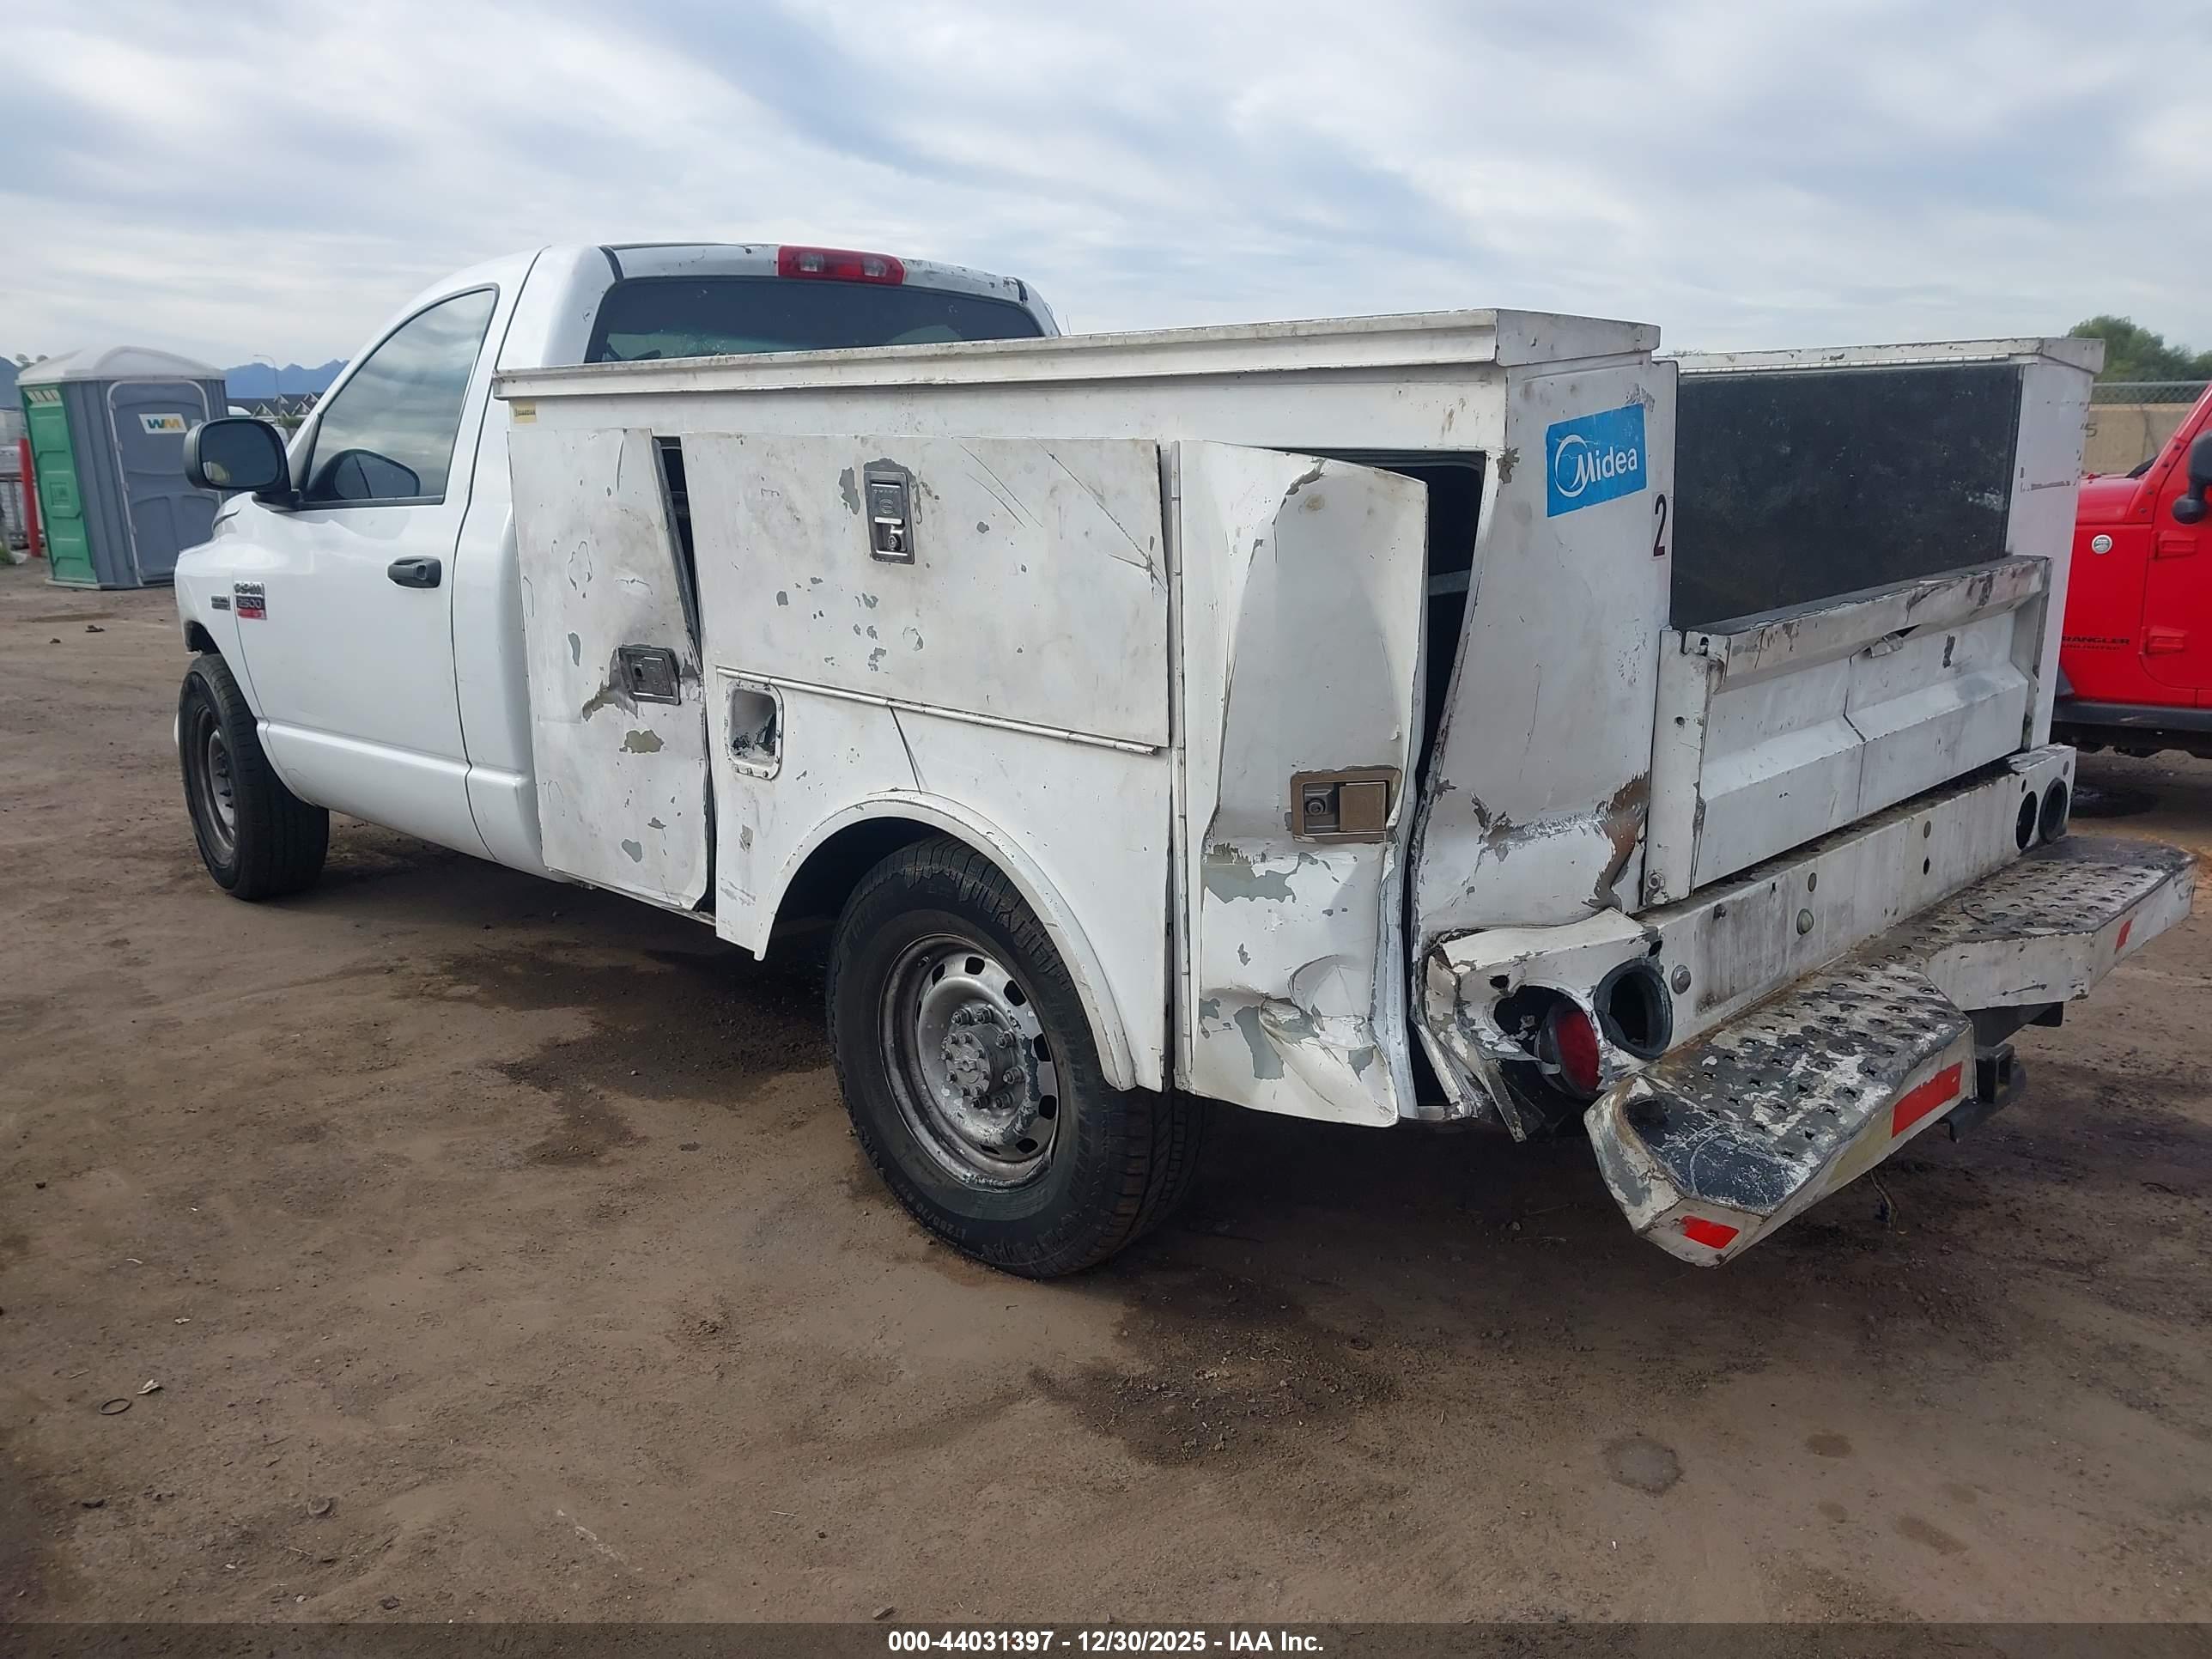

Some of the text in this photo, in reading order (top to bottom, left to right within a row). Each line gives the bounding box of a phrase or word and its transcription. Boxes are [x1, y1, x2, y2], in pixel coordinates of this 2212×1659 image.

[146, 418, 180, 429] WM
[1561, 440, 1638, 491] Midea
[1653, 494, 1667, 556] 2
[236, 598, 262, 610] 2500
[2062, 635, 2130, 646] RANGLER
